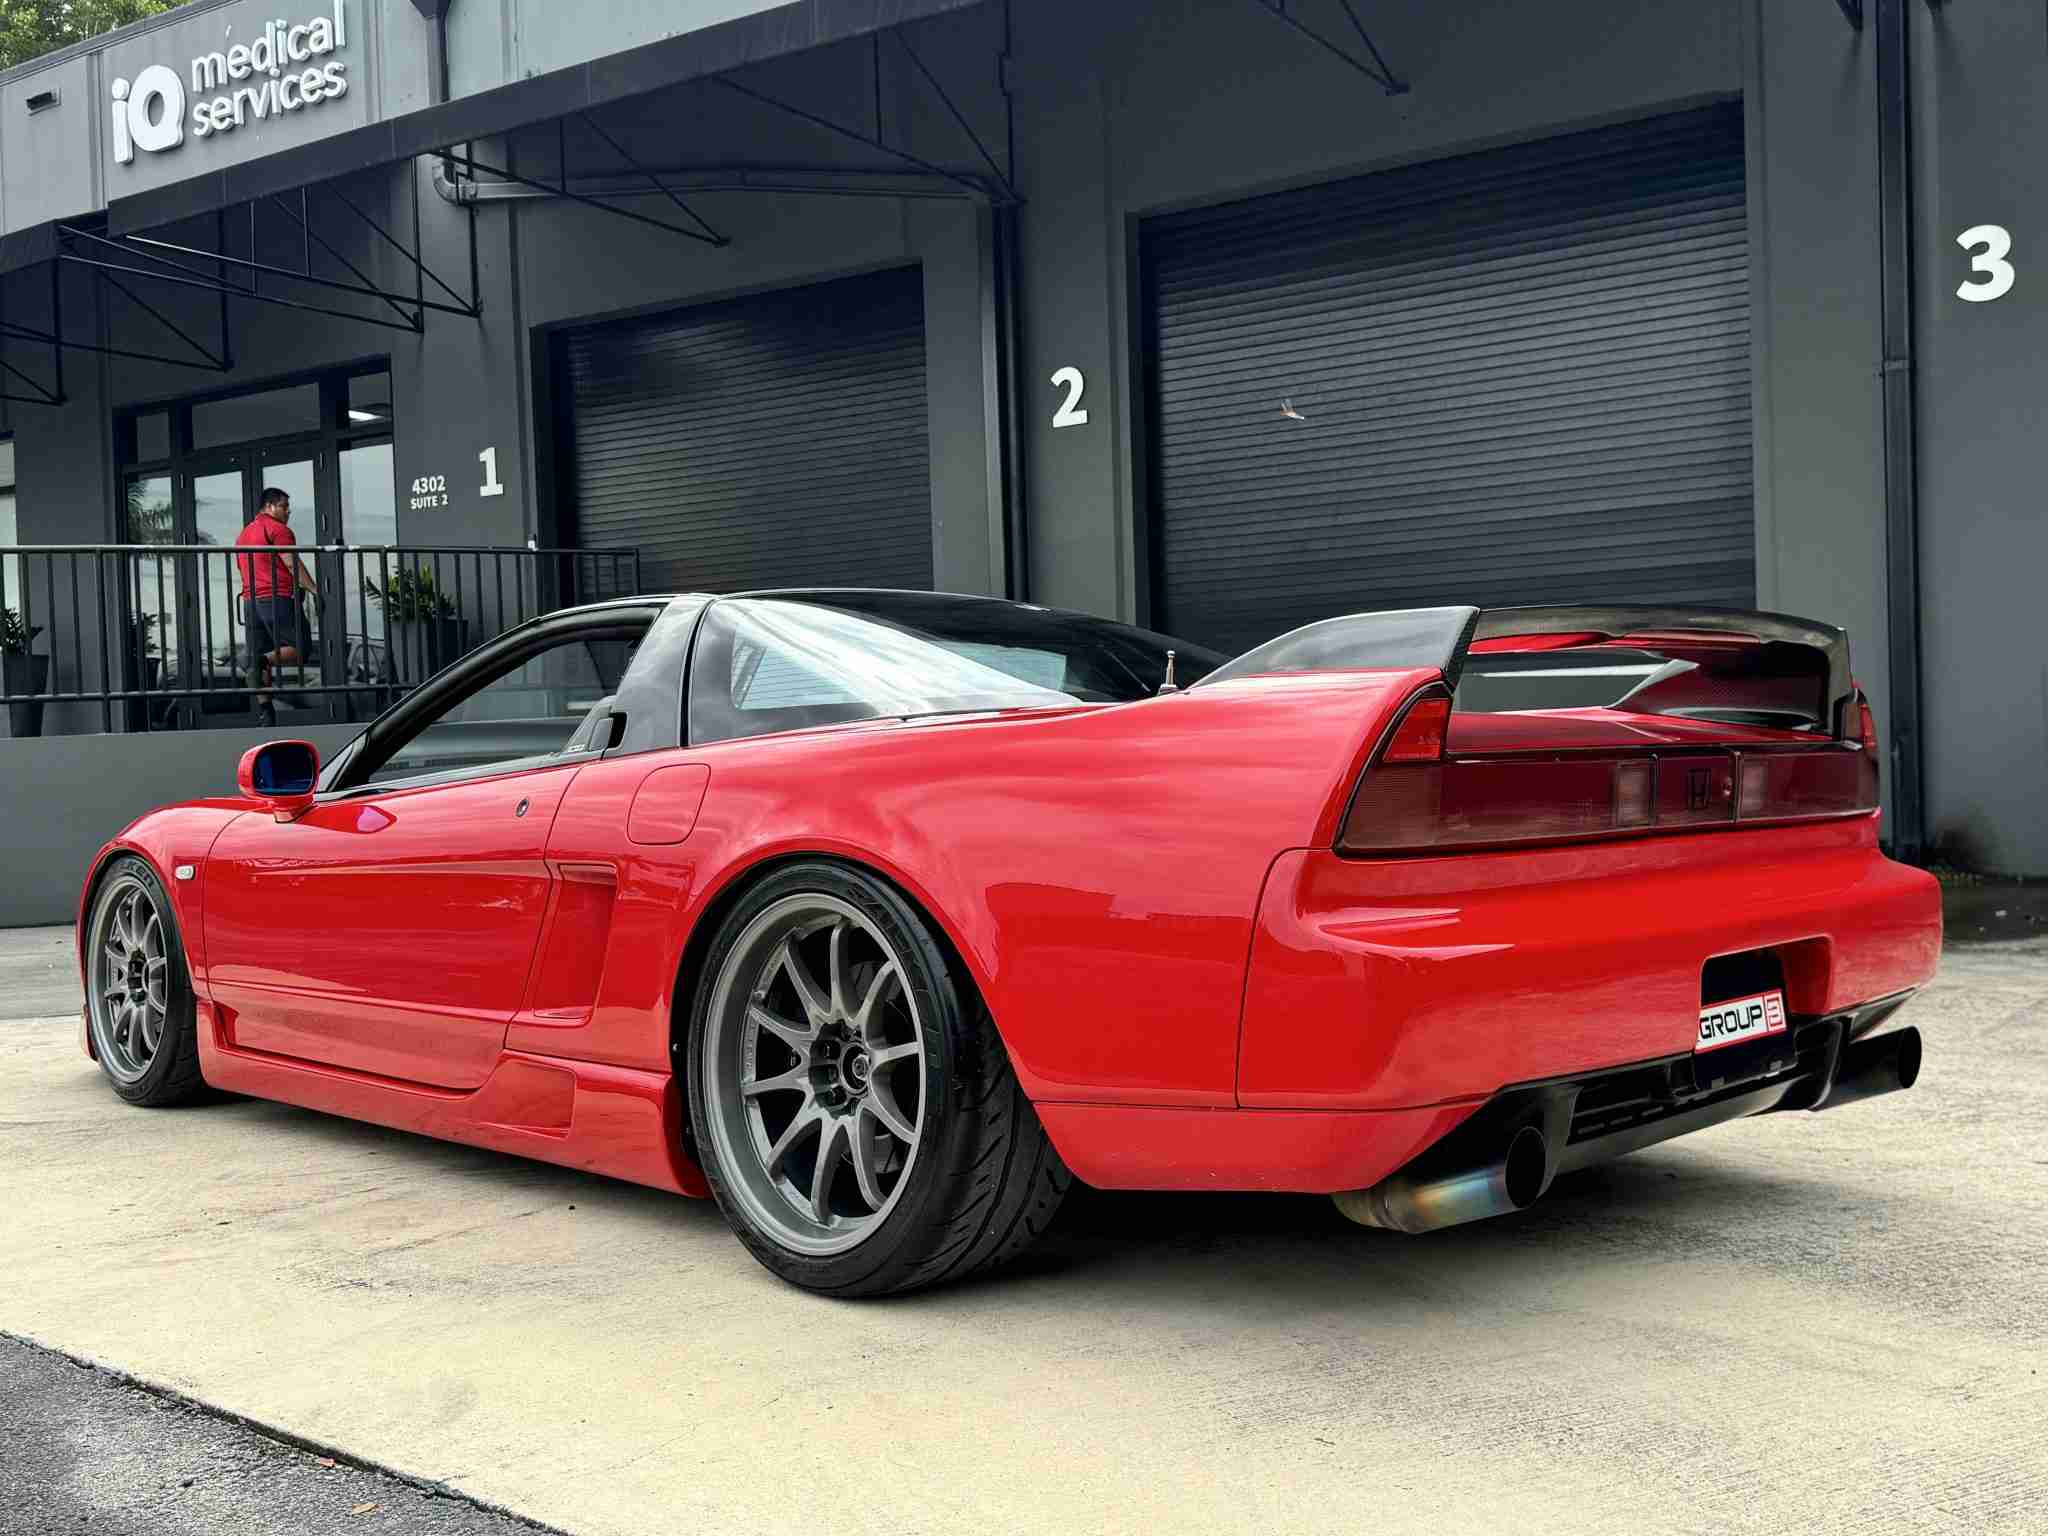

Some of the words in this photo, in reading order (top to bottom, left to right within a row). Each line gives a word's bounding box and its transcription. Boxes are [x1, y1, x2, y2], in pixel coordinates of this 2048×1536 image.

[191, 0, 346, 92] medical
[193, 61, 348, 137] services
[1956, 224, 2015, 302] 3
[1050, 366, 1088, 428] 2
[412, 475, 446, 495] 4302
[479, 447, 504, 497] 1
[410, 495, 438, 510] SUITE
[441, 494, 448, 506] 2
[1699, 1004, 1763, 1040] GROUP
